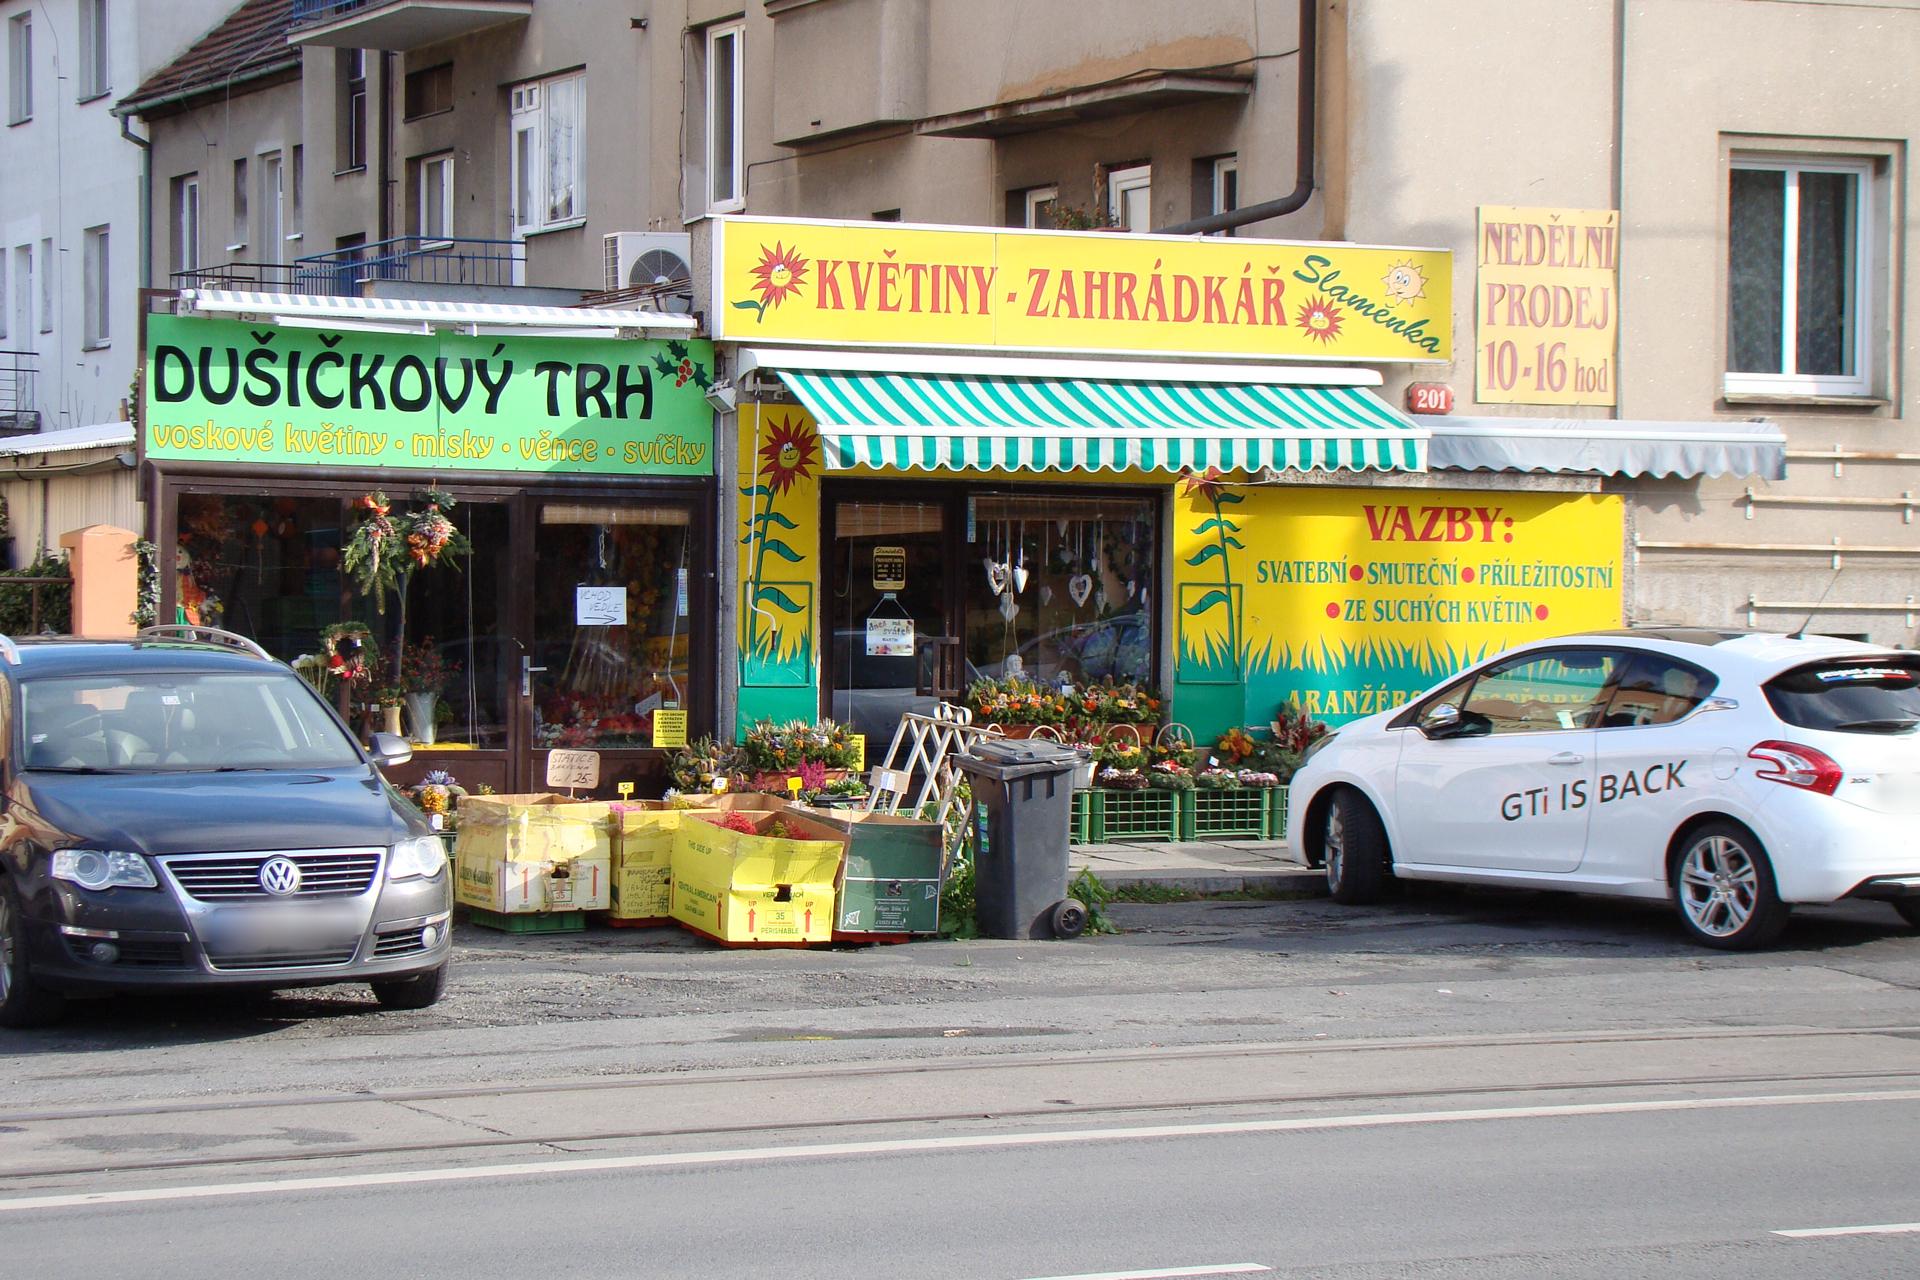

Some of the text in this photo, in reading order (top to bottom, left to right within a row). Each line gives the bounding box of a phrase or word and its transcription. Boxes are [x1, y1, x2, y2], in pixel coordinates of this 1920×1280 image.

[1483, 213, 1615, 269] NEDĚLNÍ
[816, 249, 998, 314] KVĚTINY
[1025, 258, 1288, 326] ZAHRÁDKÁŘ
[1293, 254, 1441, 353] Slaměnka
[1486, 283, 1609, 329] PRODEJ
[155, 330, 654, 419] DUŠIČKOVÝ TRH
[1575, 358, 1608, 392] hod
[1417, 389, 1447, 409] 201
[153, 420, 705, 465] voskové květiny misky věnce svíčky
[1362, 505, 1514, 543] VAZBY:
[1256, 554, 1614, 588] SVATEBNÍ SMUTEČNÍ PŘÍLEŽITOSTNÍ
[1343, 594, 1532, 623] ZE SUCHÝCH KVĚTIN
[1501, 759, 1688, 821] GTi IS BACK
[775, 912, 785, 920] 35
